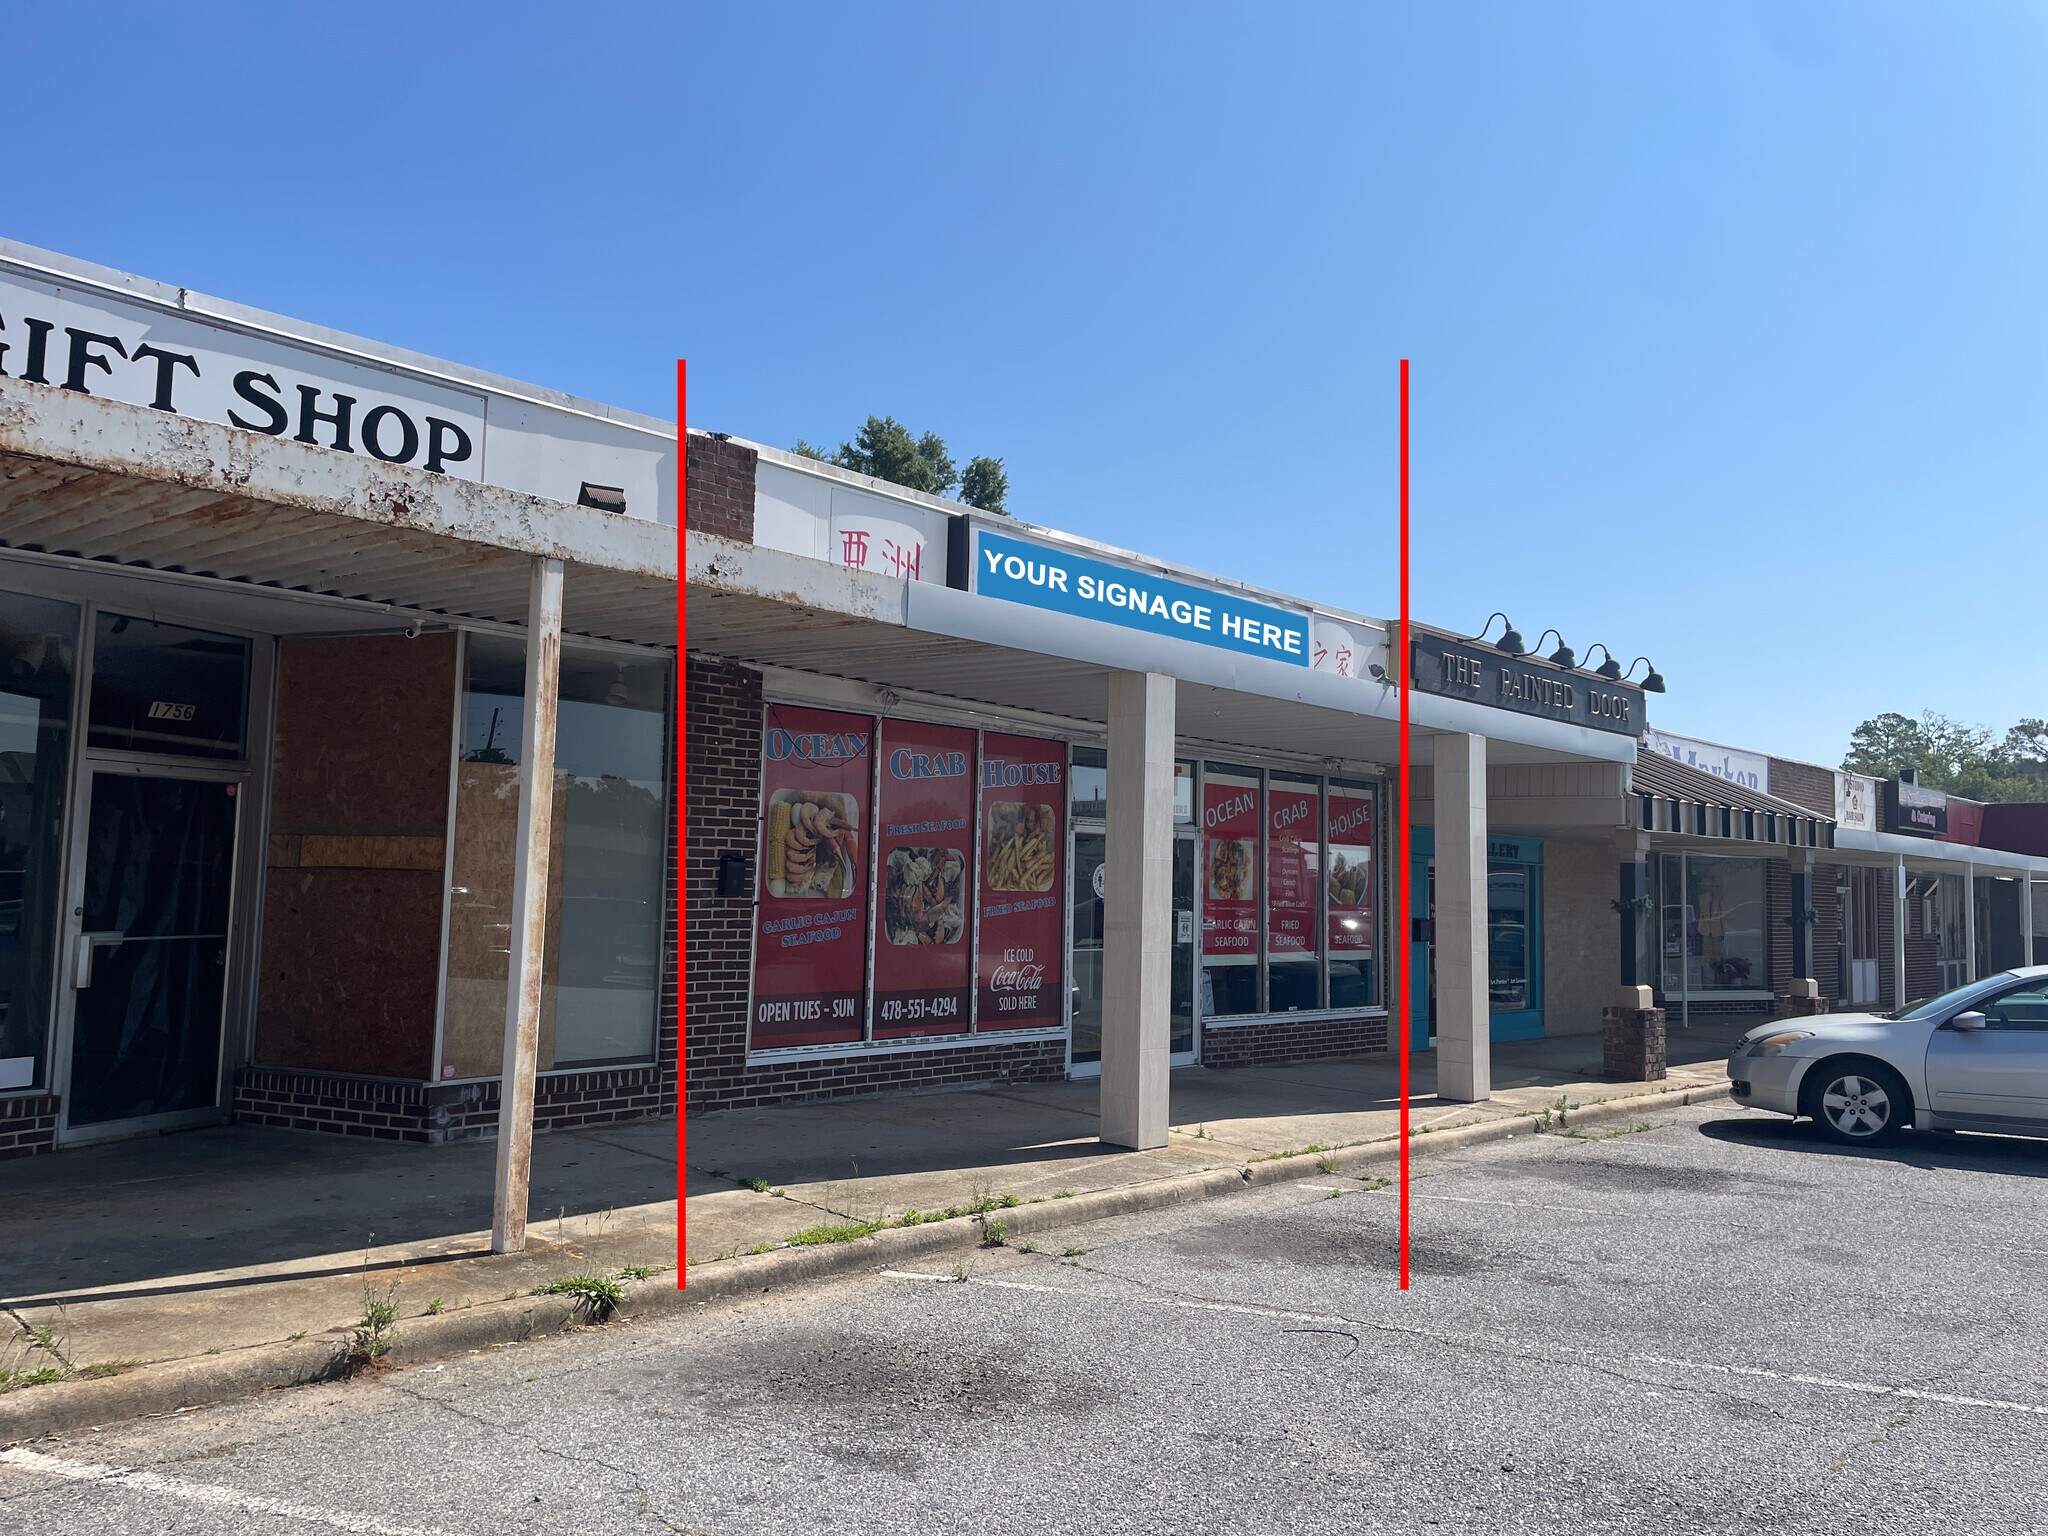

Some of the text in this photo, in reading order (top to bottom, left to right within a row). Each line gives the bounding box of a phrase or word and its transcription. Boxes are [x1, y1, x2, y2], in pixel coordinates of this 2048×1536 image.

[0, 312, 472, 473] IFT SHOP
[1442, 652, 1630, 721] THE PAINTED DOOR
[152, 703, 194, 719] 1756
[766, 728, 869, 761] OCEAN
[889, 748, 967, 779] CRAB
[982, 759, 1062, 789] HOUSE
[1205, 791, 1255, 828] OCEAN
[1273, 800, 1308, 829] CRAB
[886, 818, 966, 837] FRESH SEAFOOD
[1329, 804, 1370, 838] HOUSE
[983, 897, 1057, 918] FRIED SEAFOOD
[763, 908, 857, 933] GARLIC CAJUN
[1233, 919, 1256, 930] CAJUN
[1281, 920, 1300, 930] FRIED
[781, 927, 842, 948] SEAFOOD
[1215, 936, 1249, 947] SEAFOOD
[1275, 936, 1306, 946] SEAFOOD
[1334, 934, 1363, 945] SEAFOOD
[1003, 948, 1034, 962] ICE COLD
[758, 1002, 790, 1023] OPEN
[793, 1000, 821, 1020] TUES
[832, 999, 855, 1017] SUN
[880, 997, 958, 1021] 478-551-4294
[998, 995, 1037, 1011] SOLD HERE
